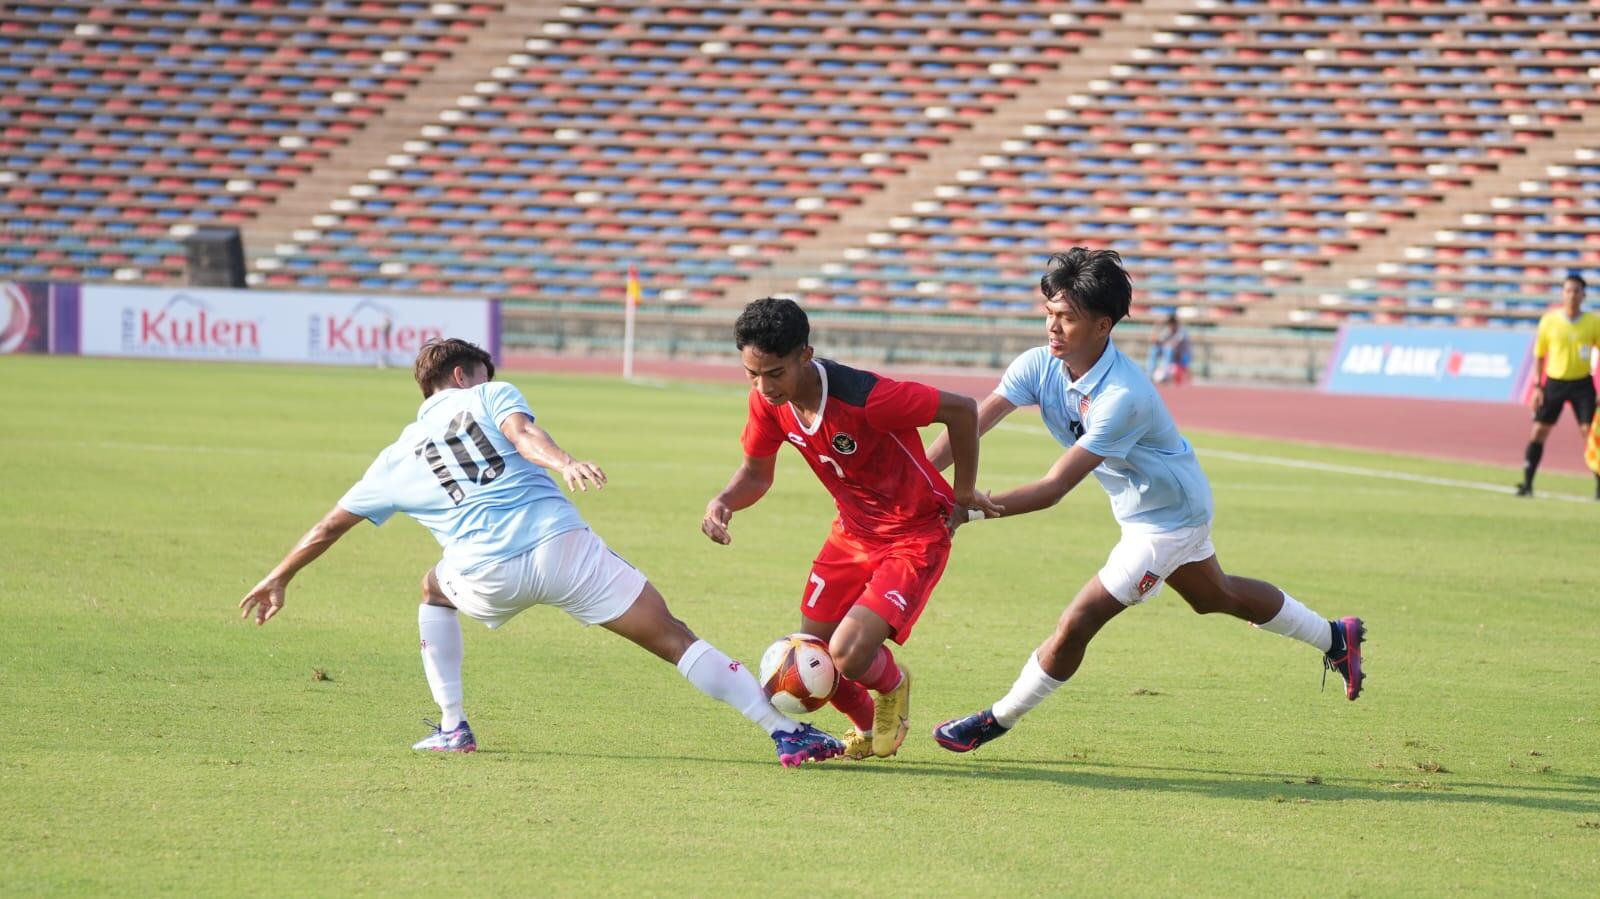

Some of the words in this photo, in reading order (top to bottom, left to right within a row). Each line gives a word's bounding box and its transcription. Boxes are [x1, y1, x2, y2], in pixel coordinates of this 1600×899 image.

[141, 309, 258, 346] Kulen
[1386, 346, 1442, 377] BANK
[414, 411, 505, 505] 10
[818, 454, 845, 478] 7
[807, 572, 826, 608] 7
